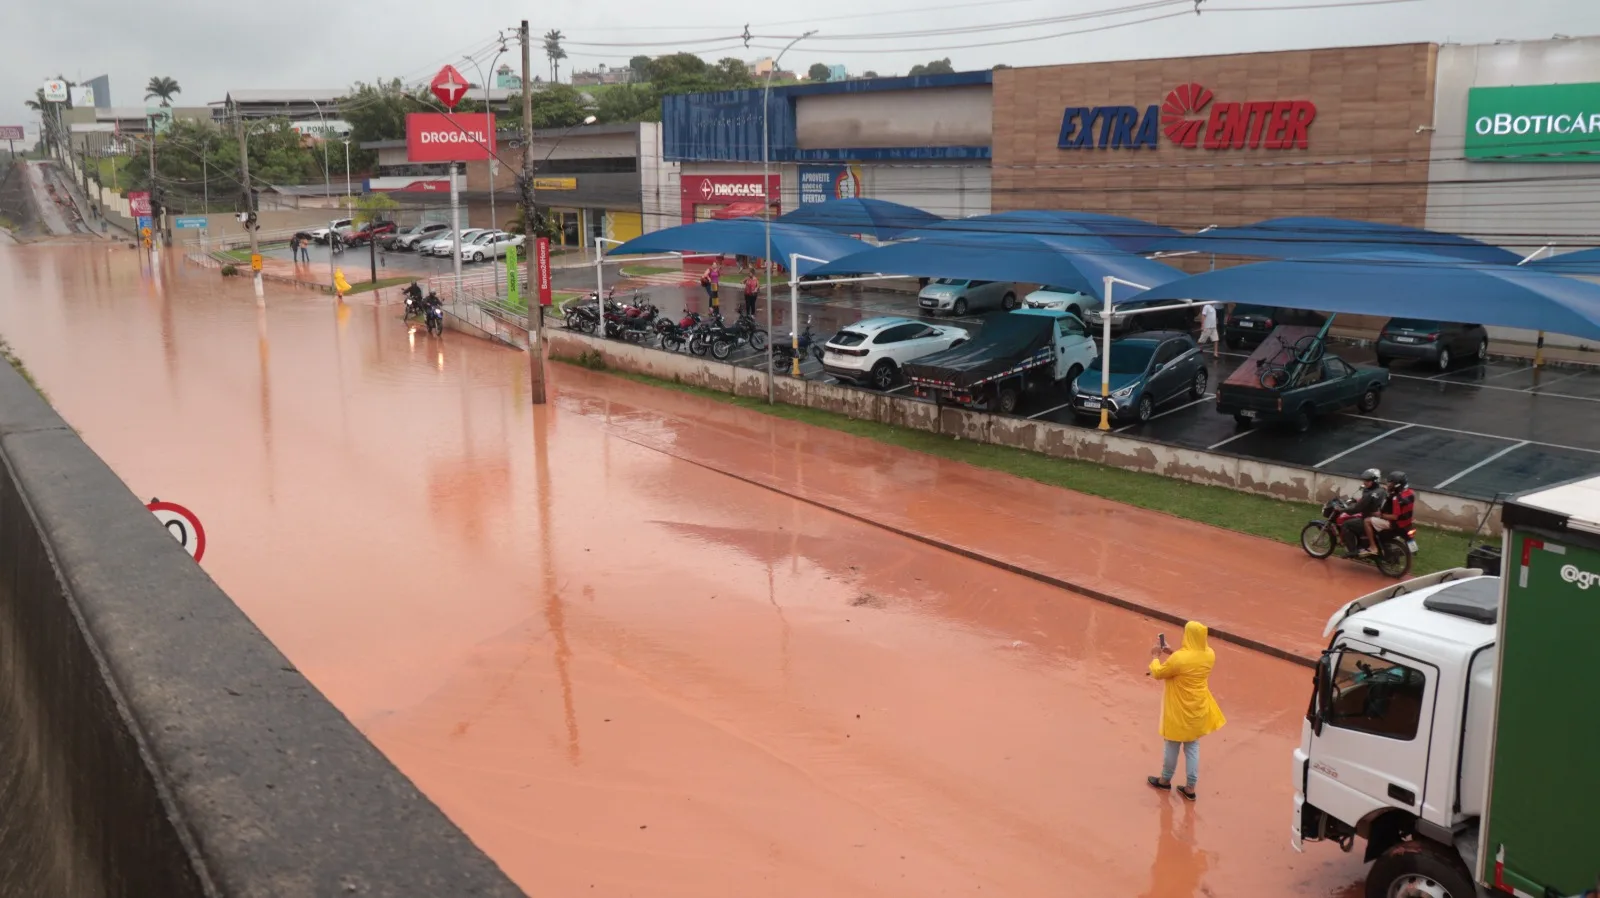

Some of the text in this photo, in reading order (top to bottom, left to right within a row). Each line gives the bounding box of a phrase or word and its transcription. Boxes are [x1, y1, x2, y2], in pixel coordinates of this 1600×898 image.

[1057, 105, 1160, 150] EXTRA
[421, 131, 486, 143] DROGASIL
[715, 184, 765, 196] DROGASIL
